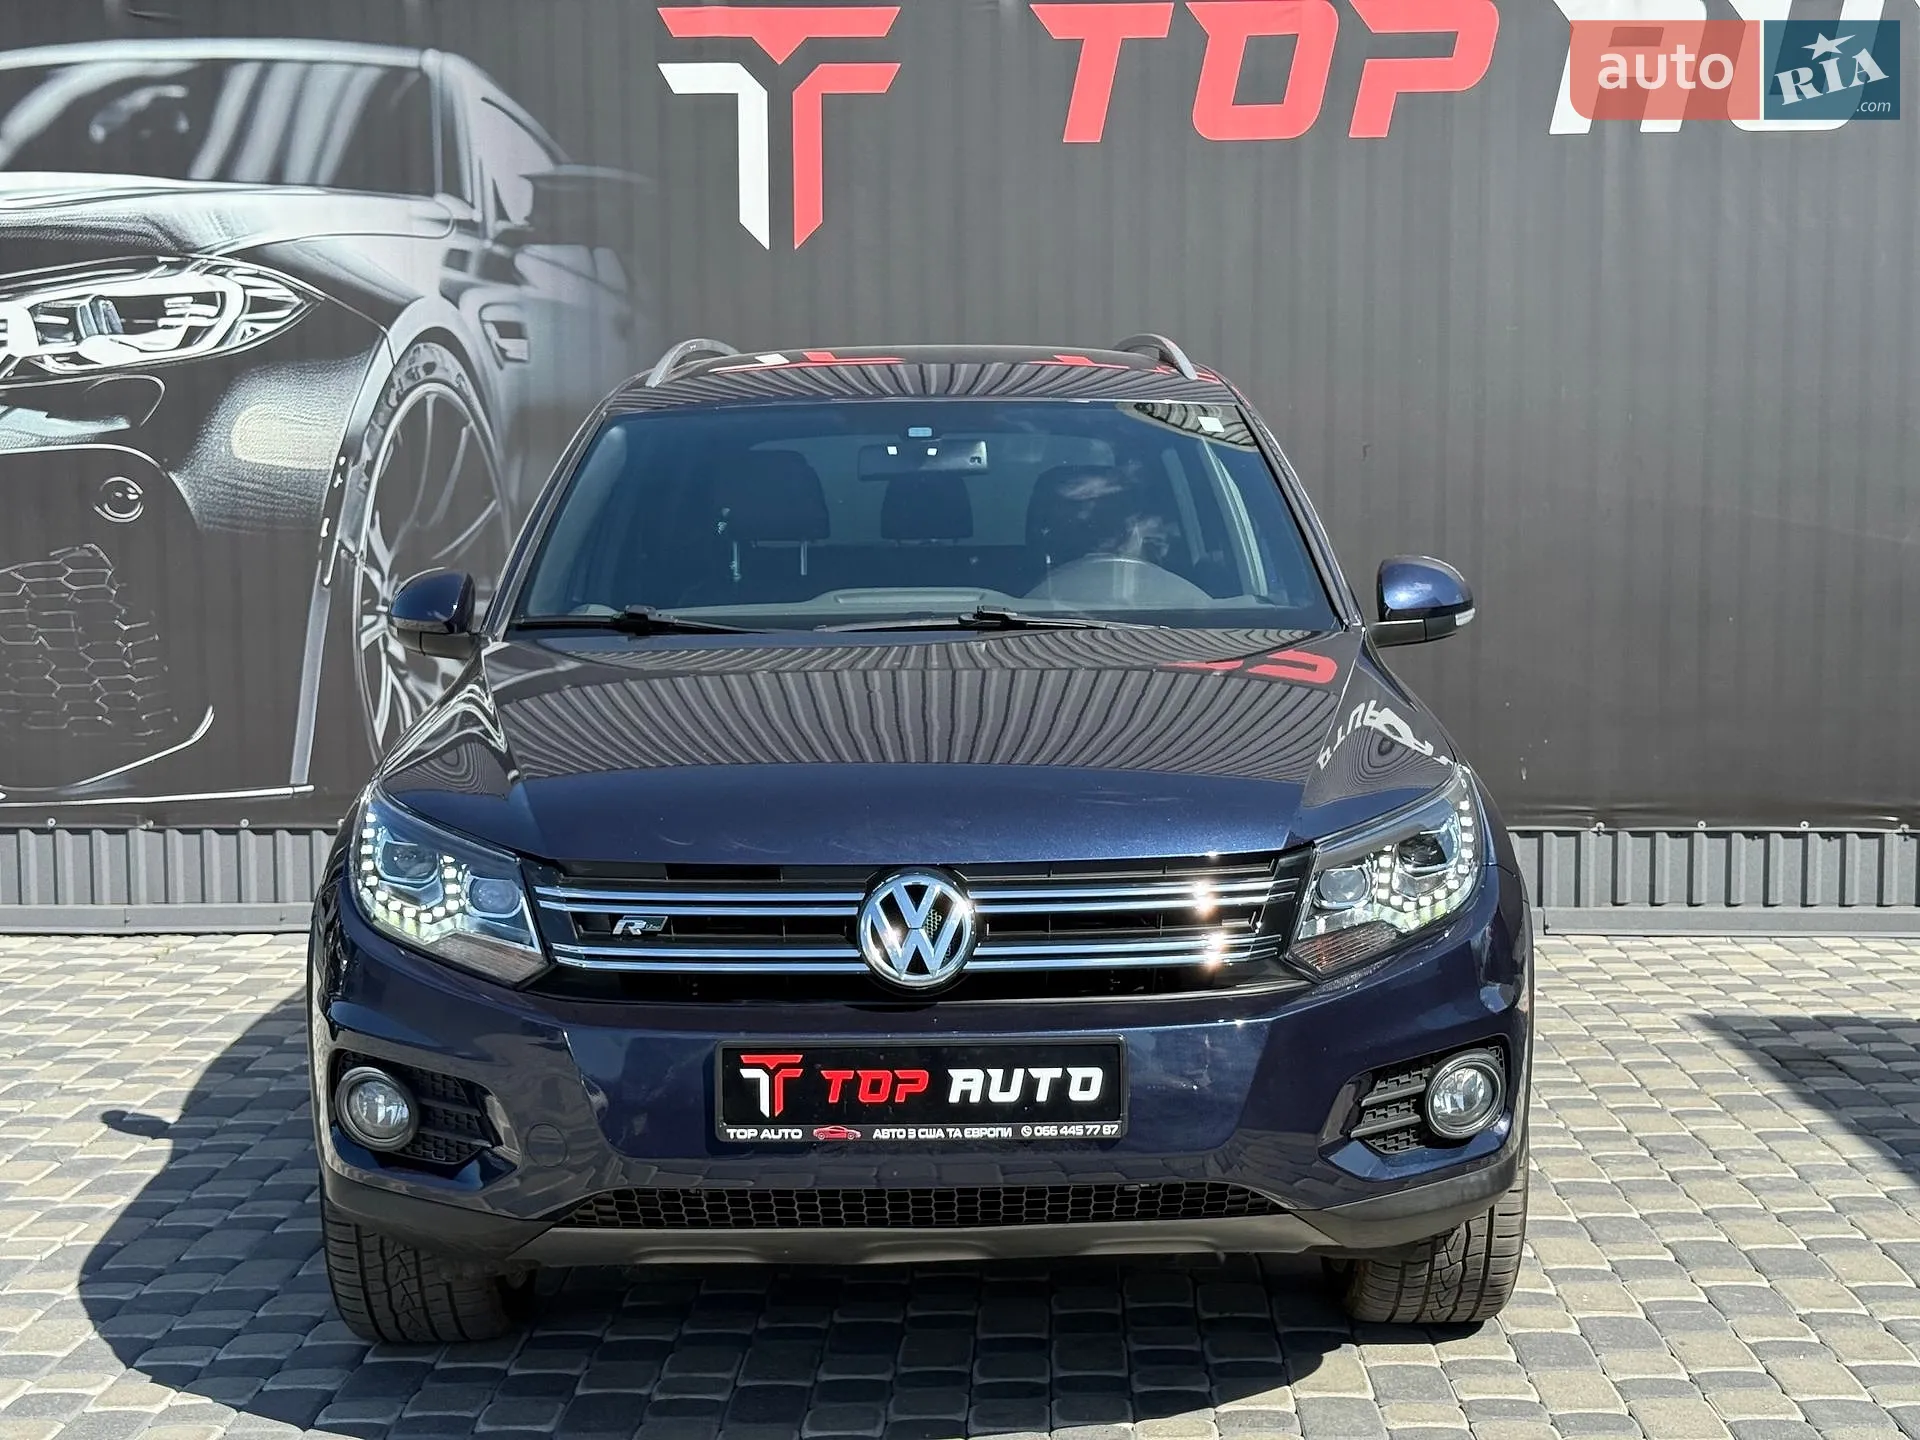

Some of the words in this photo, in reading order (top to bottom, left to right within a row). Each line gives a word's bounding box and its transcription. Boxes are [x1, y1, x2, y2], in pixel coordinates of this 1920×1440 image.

[1030, 0, 1500, 143] TOP
[1548, 0, 1920, 135] AU
[820, 1069, 930, 1104] TOP
[947, 1067, 1104, 1103] AUTO
[726, 1128, 757, 1140] TOP
[760, 1128, 803, 1140] AUTO
[872, 1128, 906, 1139] АВТО
[917, 1128, 945, 1139] США
[945, 1127, 963, 1139] ТА
[963, 1126, 1013, 1138] ЄВРОПИ
[1059, 1125, 1084, 1136] 445
[1085, 1124, 1100, 1136] 77
